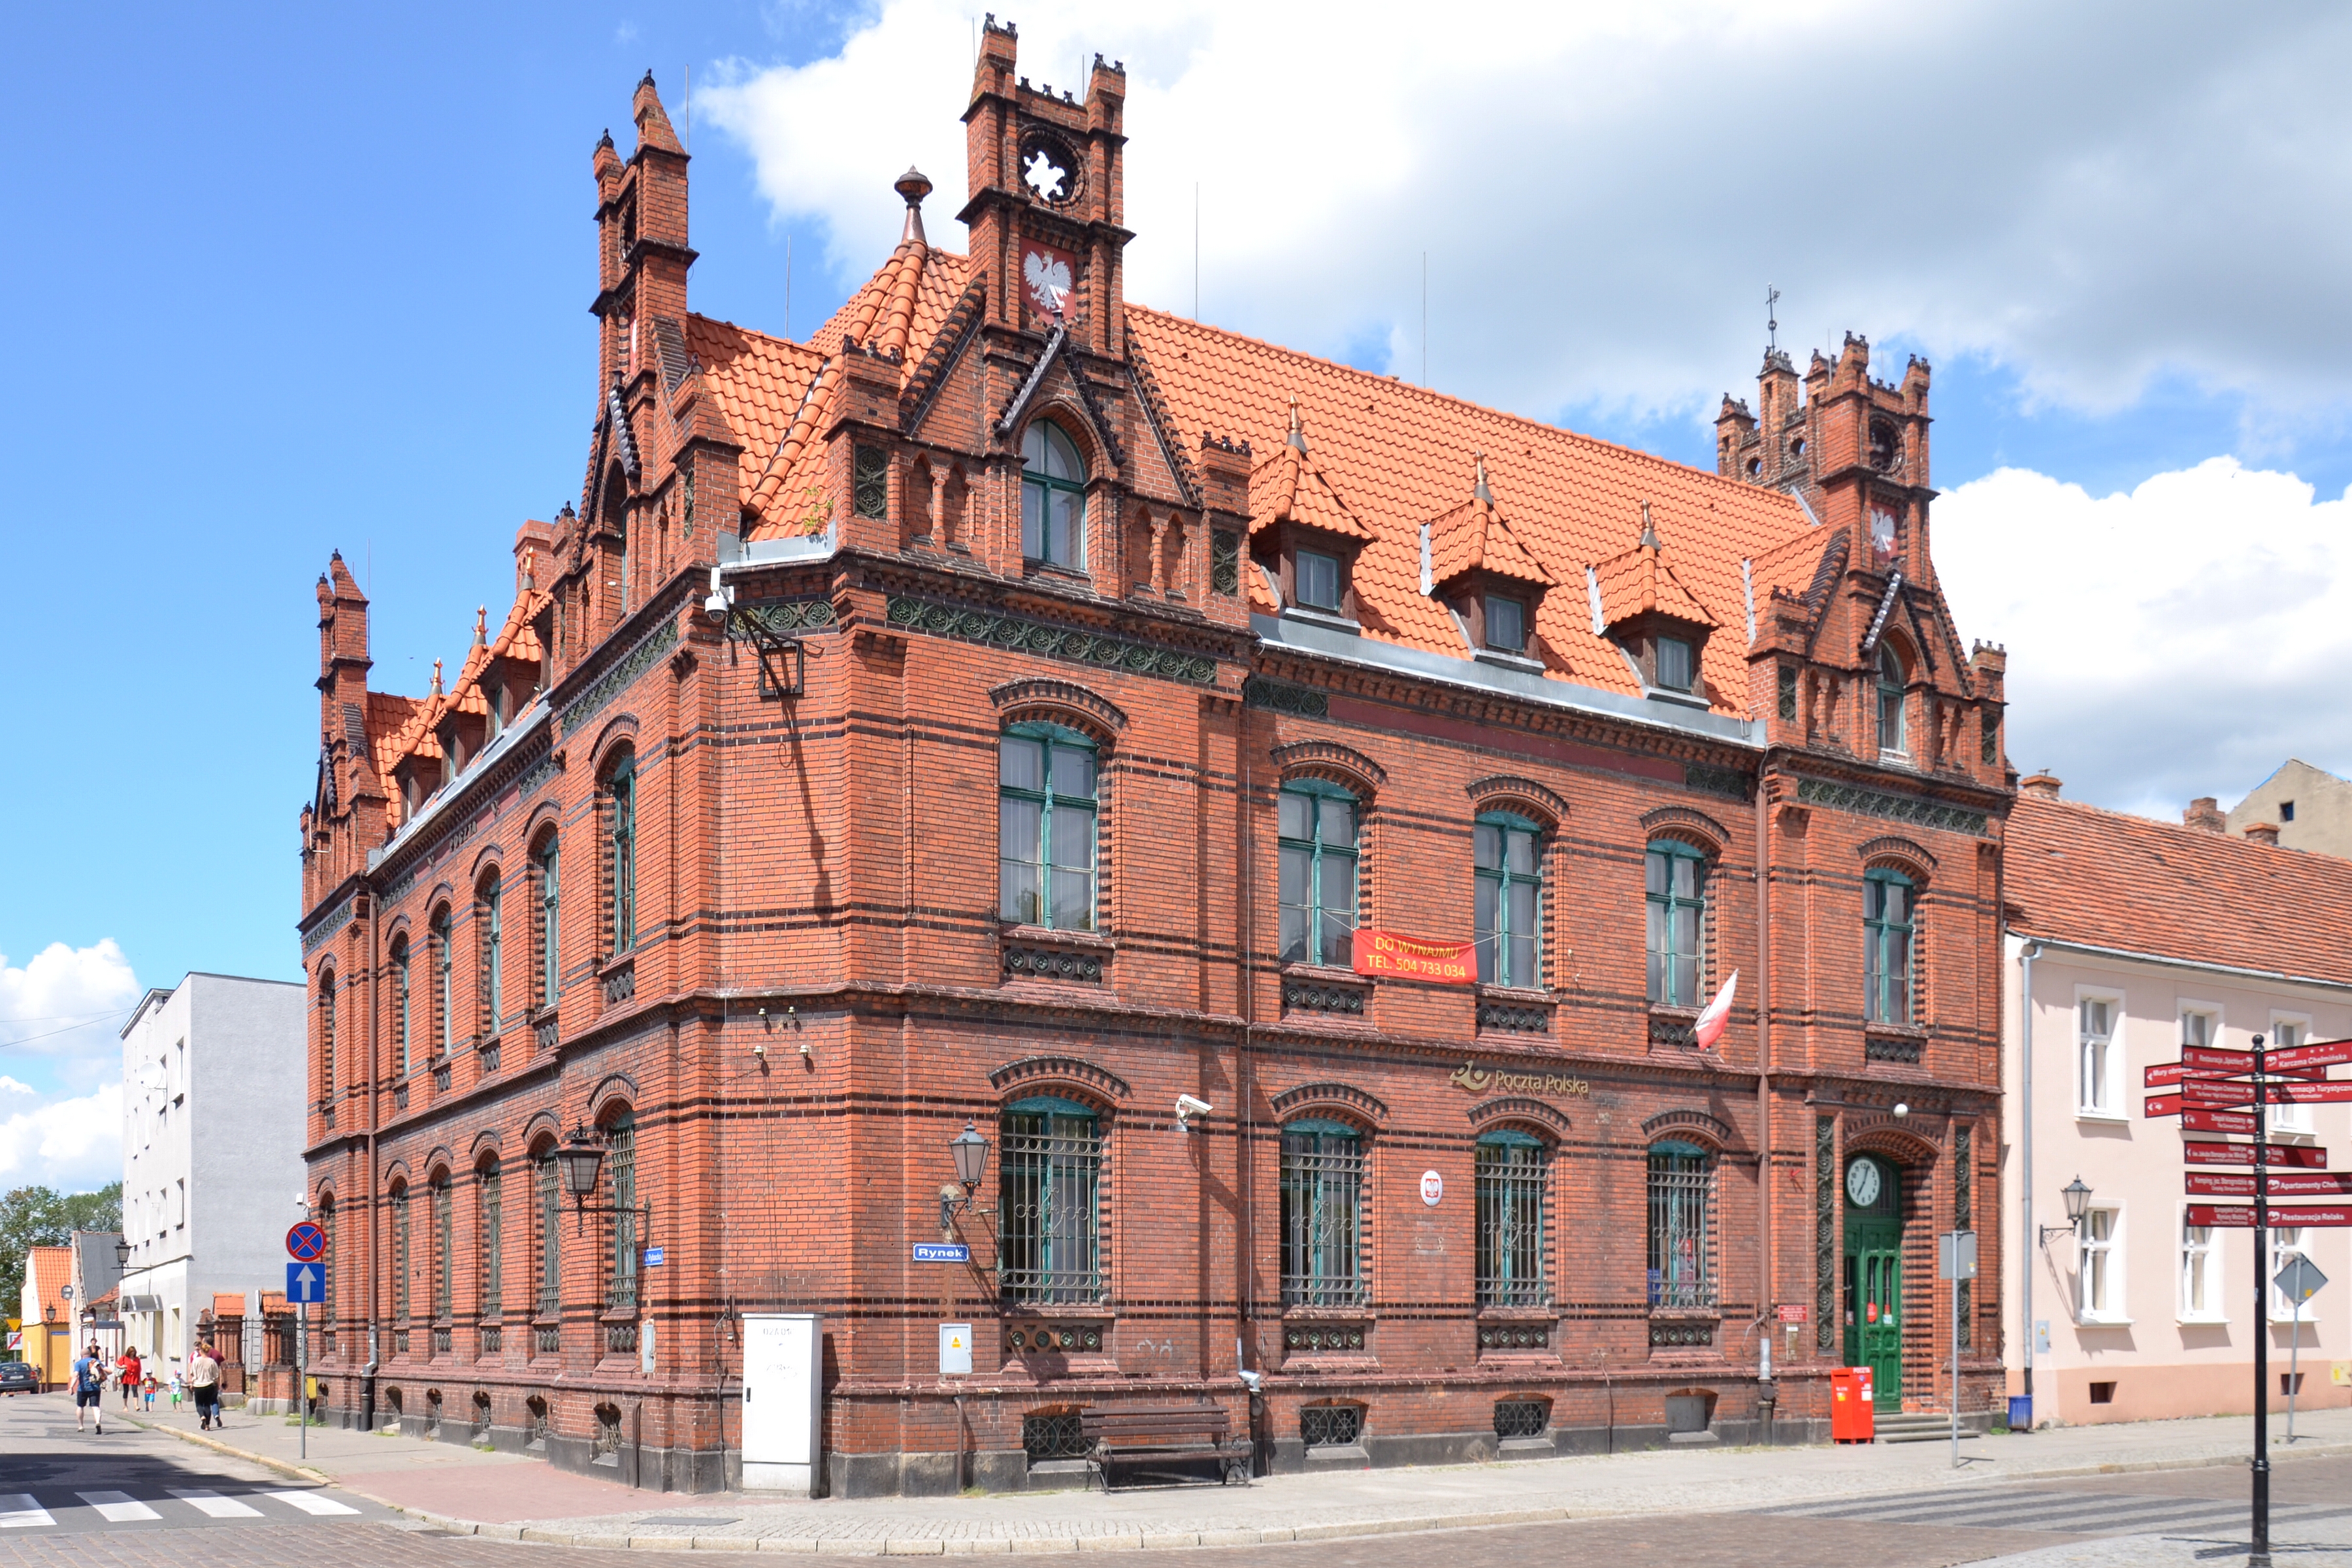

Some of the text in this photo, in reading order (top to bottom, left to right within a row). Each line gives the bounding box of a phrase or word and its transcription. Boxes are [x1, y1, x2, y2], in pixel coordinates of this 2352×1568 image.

[1375, 937, 1460, 960] DO WYNAJMU
[1367, 955, 1466, 977] TEL. 504 733 034
[2278, 1051, 2296, 1059] Hotel
[2278, 1059, 2307, 1068] Karczma
[1495, 1070, 1588, 1093] Poczta Polska
[2280, 1182, 2321, 1190] Apartamenty
[2281, 1213, 2321, 1222] Restauracja
[919, 1248, 963, 1258] Rynek
